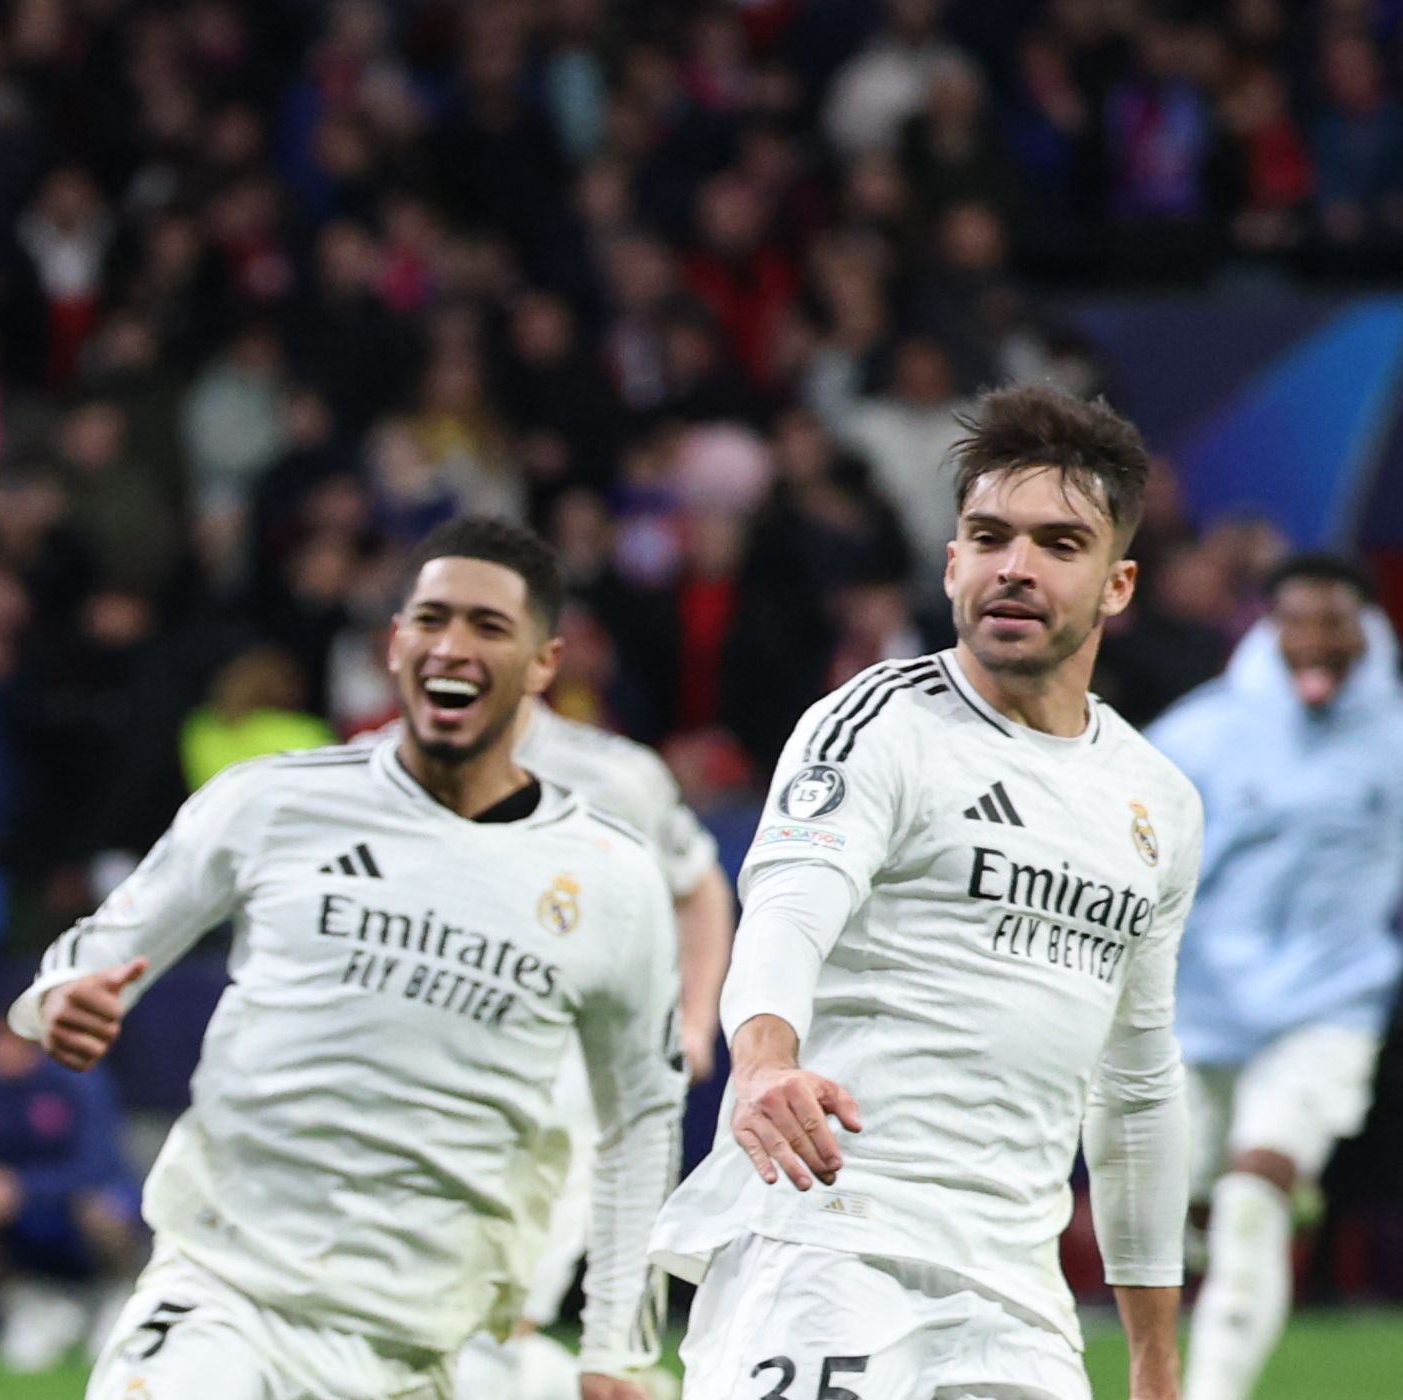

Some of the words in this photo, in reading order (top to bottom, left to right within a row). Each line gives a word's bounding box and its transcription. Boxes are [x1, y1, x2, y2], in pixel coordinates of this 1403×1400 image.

[797, 789, 819, 802] 15
[318, 893, 561, 998] Emirates
[993, 914, 1041, 957] FLY
[1048, 924, 1125, 983] BETTER
[341, 950, 399, 990] FLY
[404, 964, 518, 1027] BETTER
[125, 1301, 198, 1361] 5
